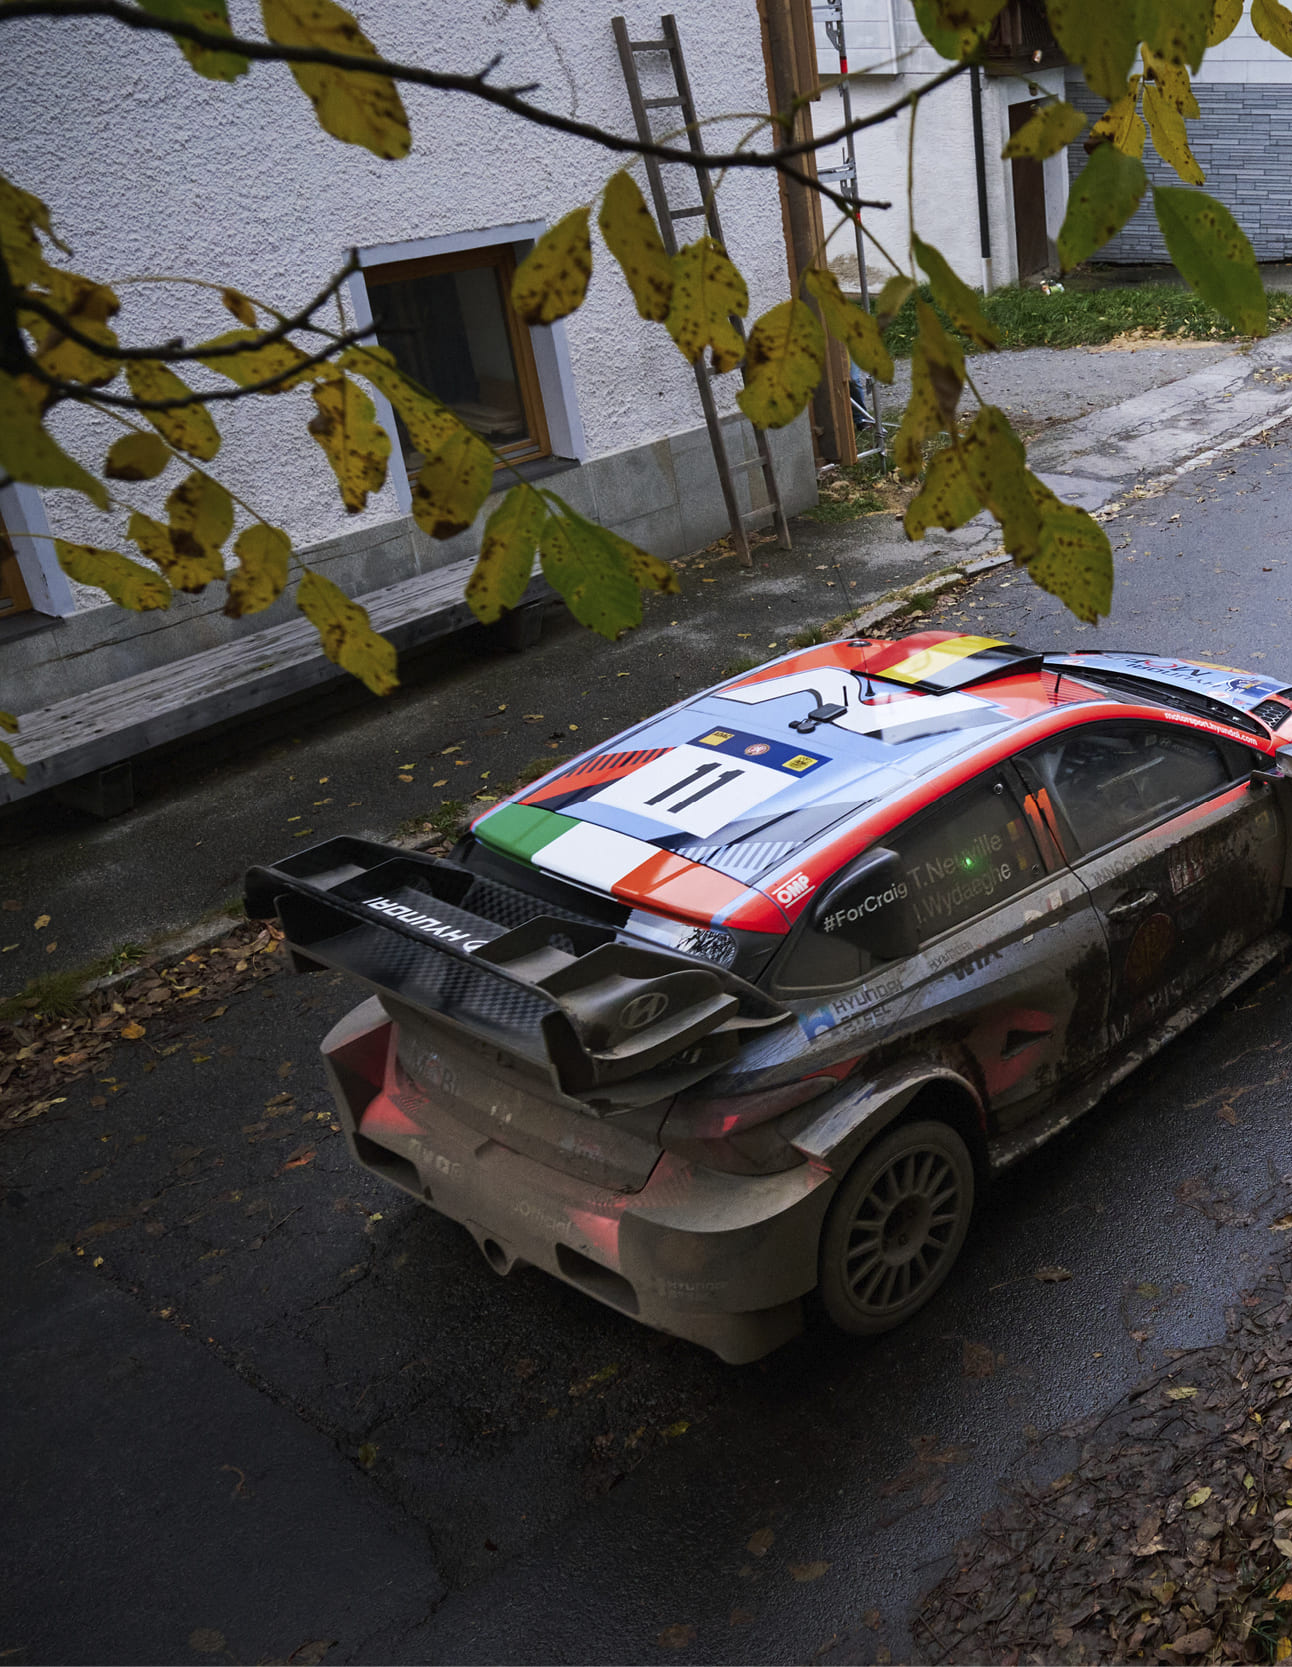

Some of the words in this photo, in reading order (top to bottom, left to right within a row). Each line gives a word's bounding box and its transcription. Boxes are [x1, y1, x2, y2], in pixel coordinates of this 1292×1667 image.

[1164, 712, 1258, 746] motorsport.hyundai.com
[643, 762, 746, 814] 11
[1023, 787, 1068, 872] 11
[776, 873, 811, 905] OMP
[824, 883, 909, 932] #ForCraig
[362, 896, 471, 942] HYUNDAI
